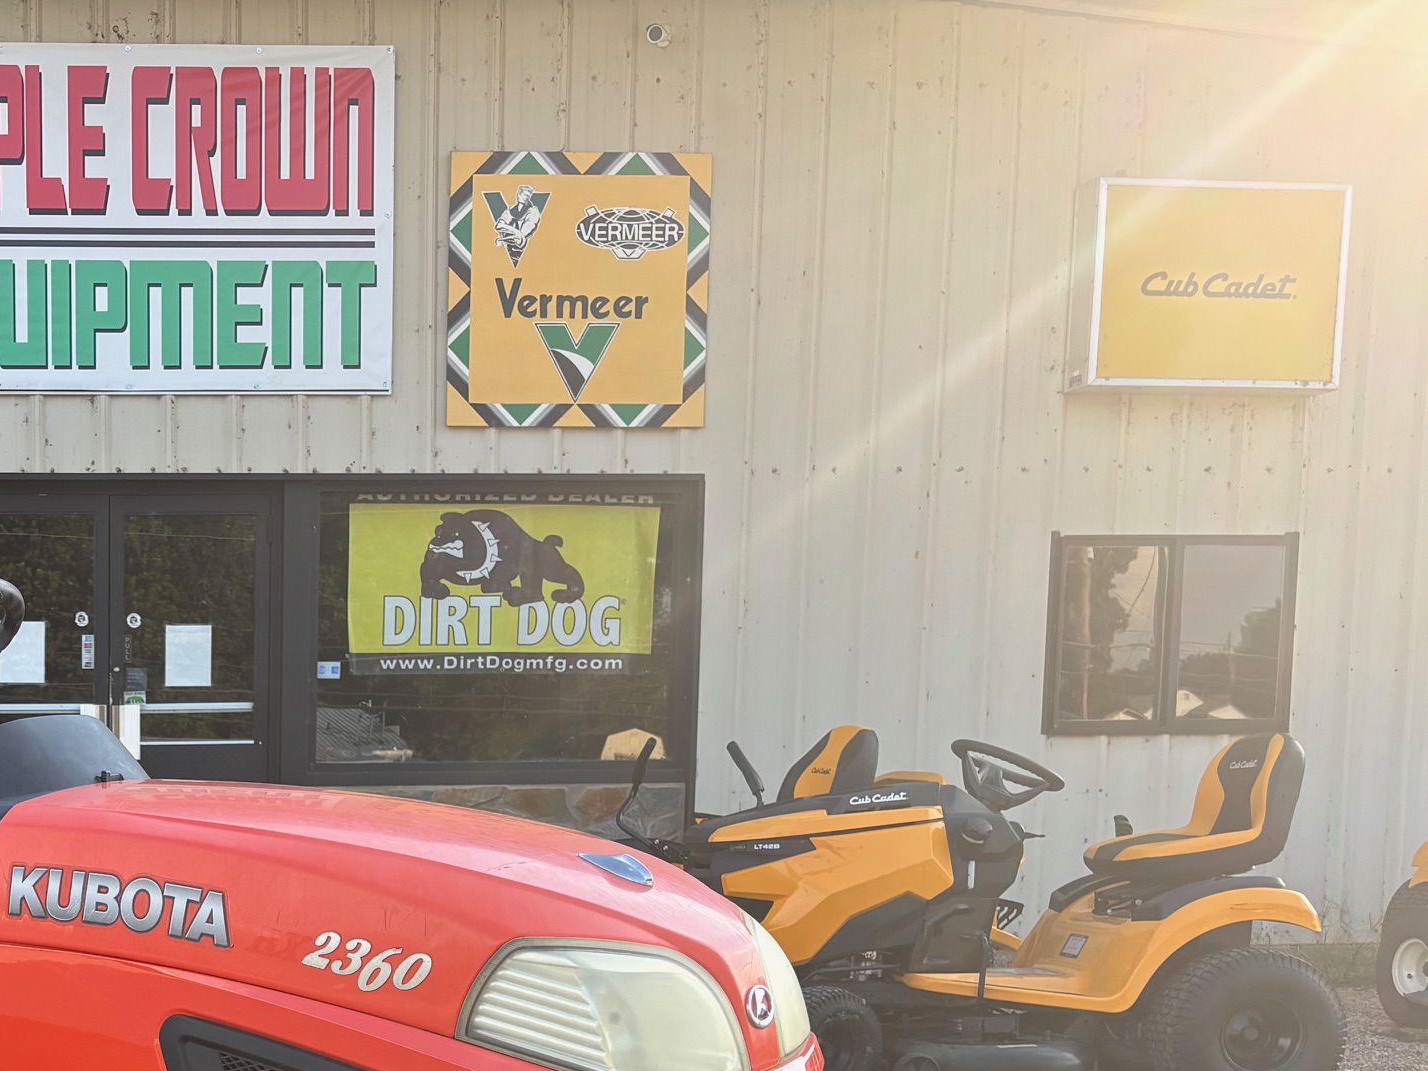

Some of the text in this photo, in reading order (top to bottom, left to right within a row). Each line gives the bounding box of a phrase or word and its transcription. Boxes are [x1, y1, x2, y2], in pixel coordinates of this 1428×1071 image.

[131, 66, 375, 217] CROWN
[579, 222, 679, 243] VERMEER
[495, 277, 649, 320] Vermeer
[1141, 271, 1296, 299] Cub Cadet
[382, 595, 622, 647] DIRT DOG
[379, 655, 623, 673] www.DirtDogmfg.com
[849, 792, 907, 805] Cub Cadet
[6, 865, 231, 949] KUBOTA
[301, 930, 433, 993] 2360
